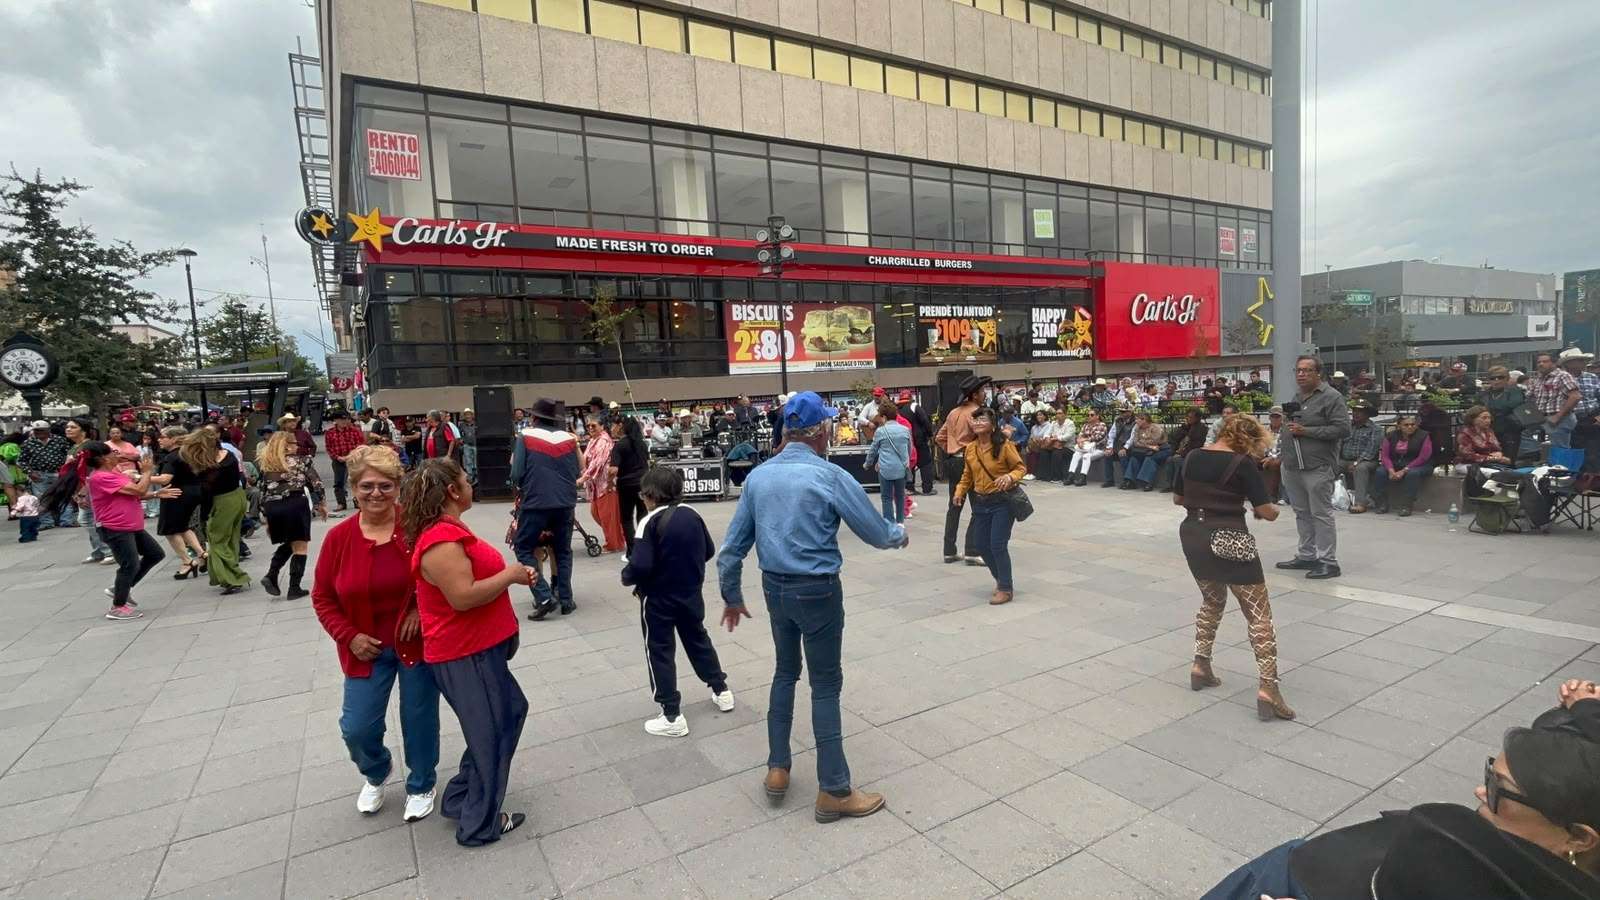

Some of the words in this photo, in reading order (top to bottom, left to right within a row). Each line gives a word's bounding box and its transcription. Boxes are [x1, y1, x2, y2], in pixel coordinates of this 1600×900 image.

[369, 132, 418, 153] RENTO
[375, 151, 419, 178] 4060044
[392, 217, 468, 245] Carl's
[472, 222, 510, 250] Jr.
[556, 236, 598, 249] MADE
[601, 239, 647, 252] FRESH
[650, 243, 668, 254] TO
[671, 244, 714, 256] ORDER
[868, 255, 931, 267] CHARGRILLED
[934, 259, 973, 269] BURGERS
[732, 304, 794, 321] BISCUITS
[952, 305, 963, 317] TU
[964, 305, 993, 317] ANTOJO
[1032, 307, 1067, 323] HAPPY
[1131, 293, 1178, 325] Carl's
[935, 318, 971, 344] $109
[1032, 322, 1058, 338] STAR
[683, 467, 698, 480] Tel
[682, 480, 697, 493] 99
[697, 478, 720, 492] 5798
